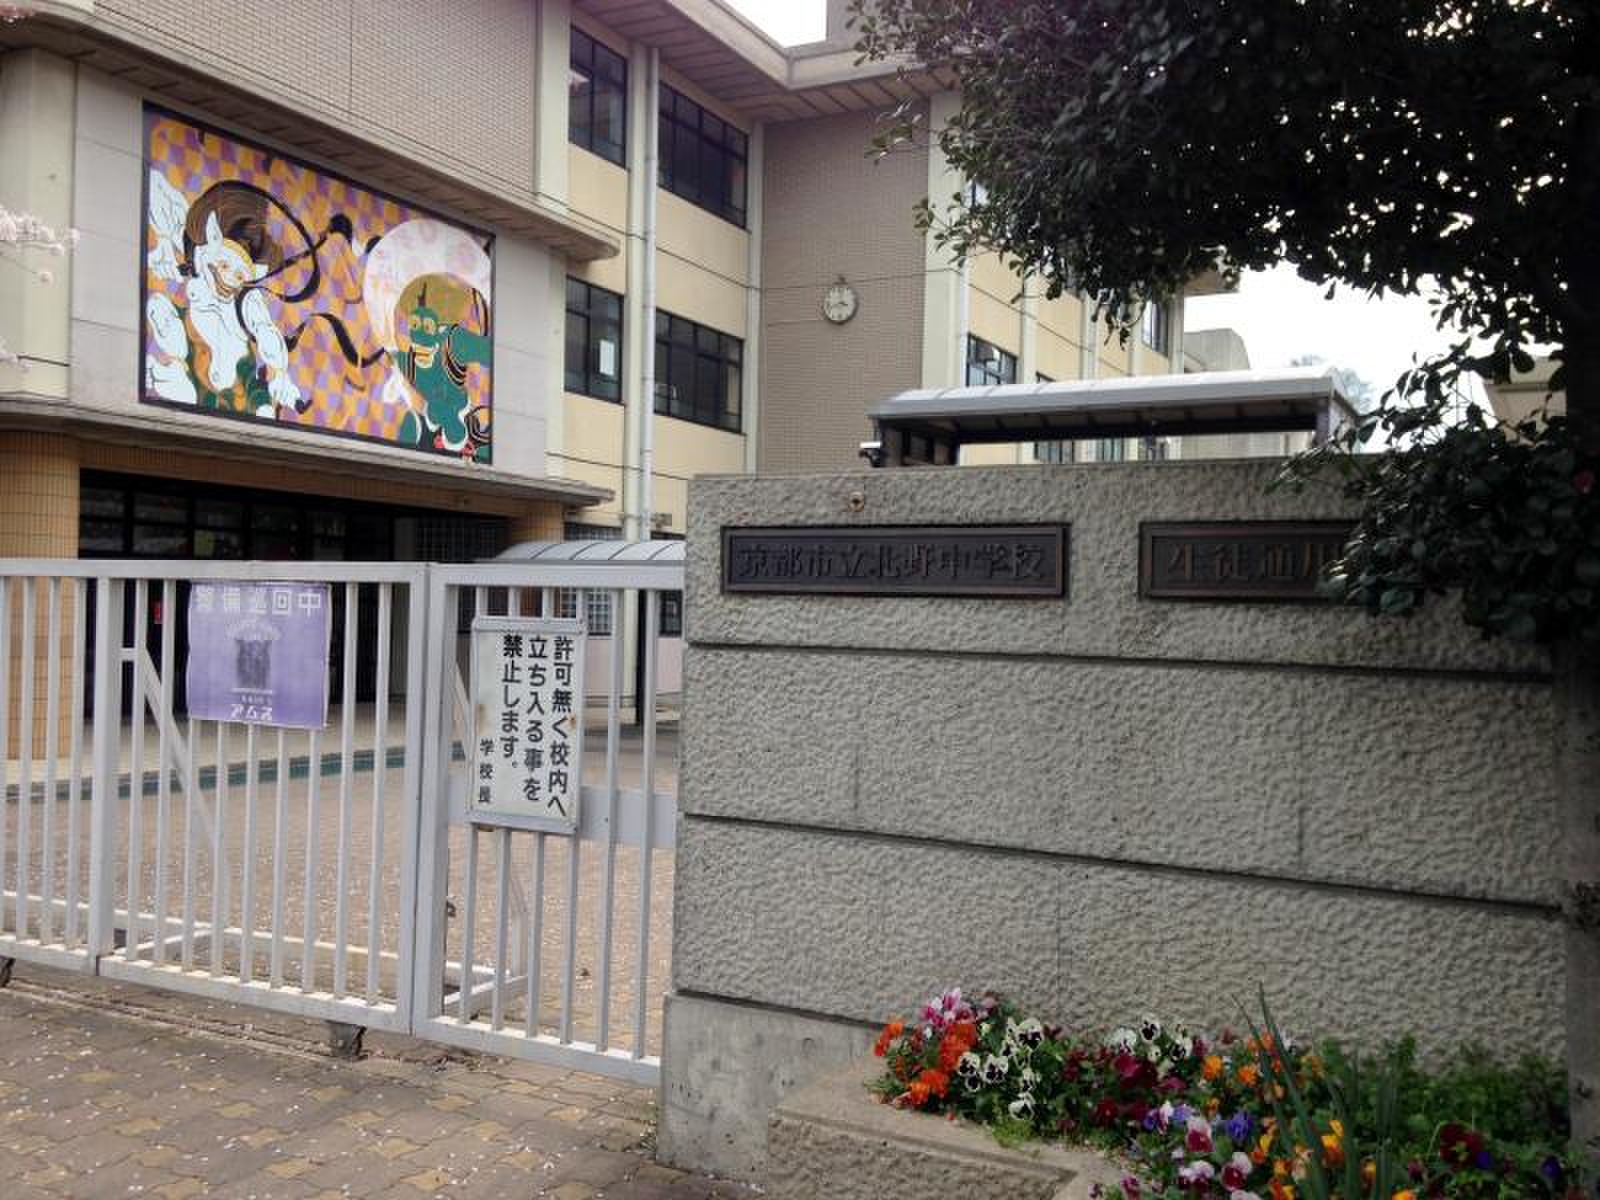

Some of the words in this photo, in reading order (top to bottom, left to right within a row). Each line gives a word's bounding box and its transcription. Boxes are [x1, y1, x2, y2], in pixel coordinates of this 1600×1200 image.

[479, 737, 494, 803] 学校長
[523, 636, 547, 801] 立ち入る事を
[547, 636, 574, 817] 許可無く校内へ
